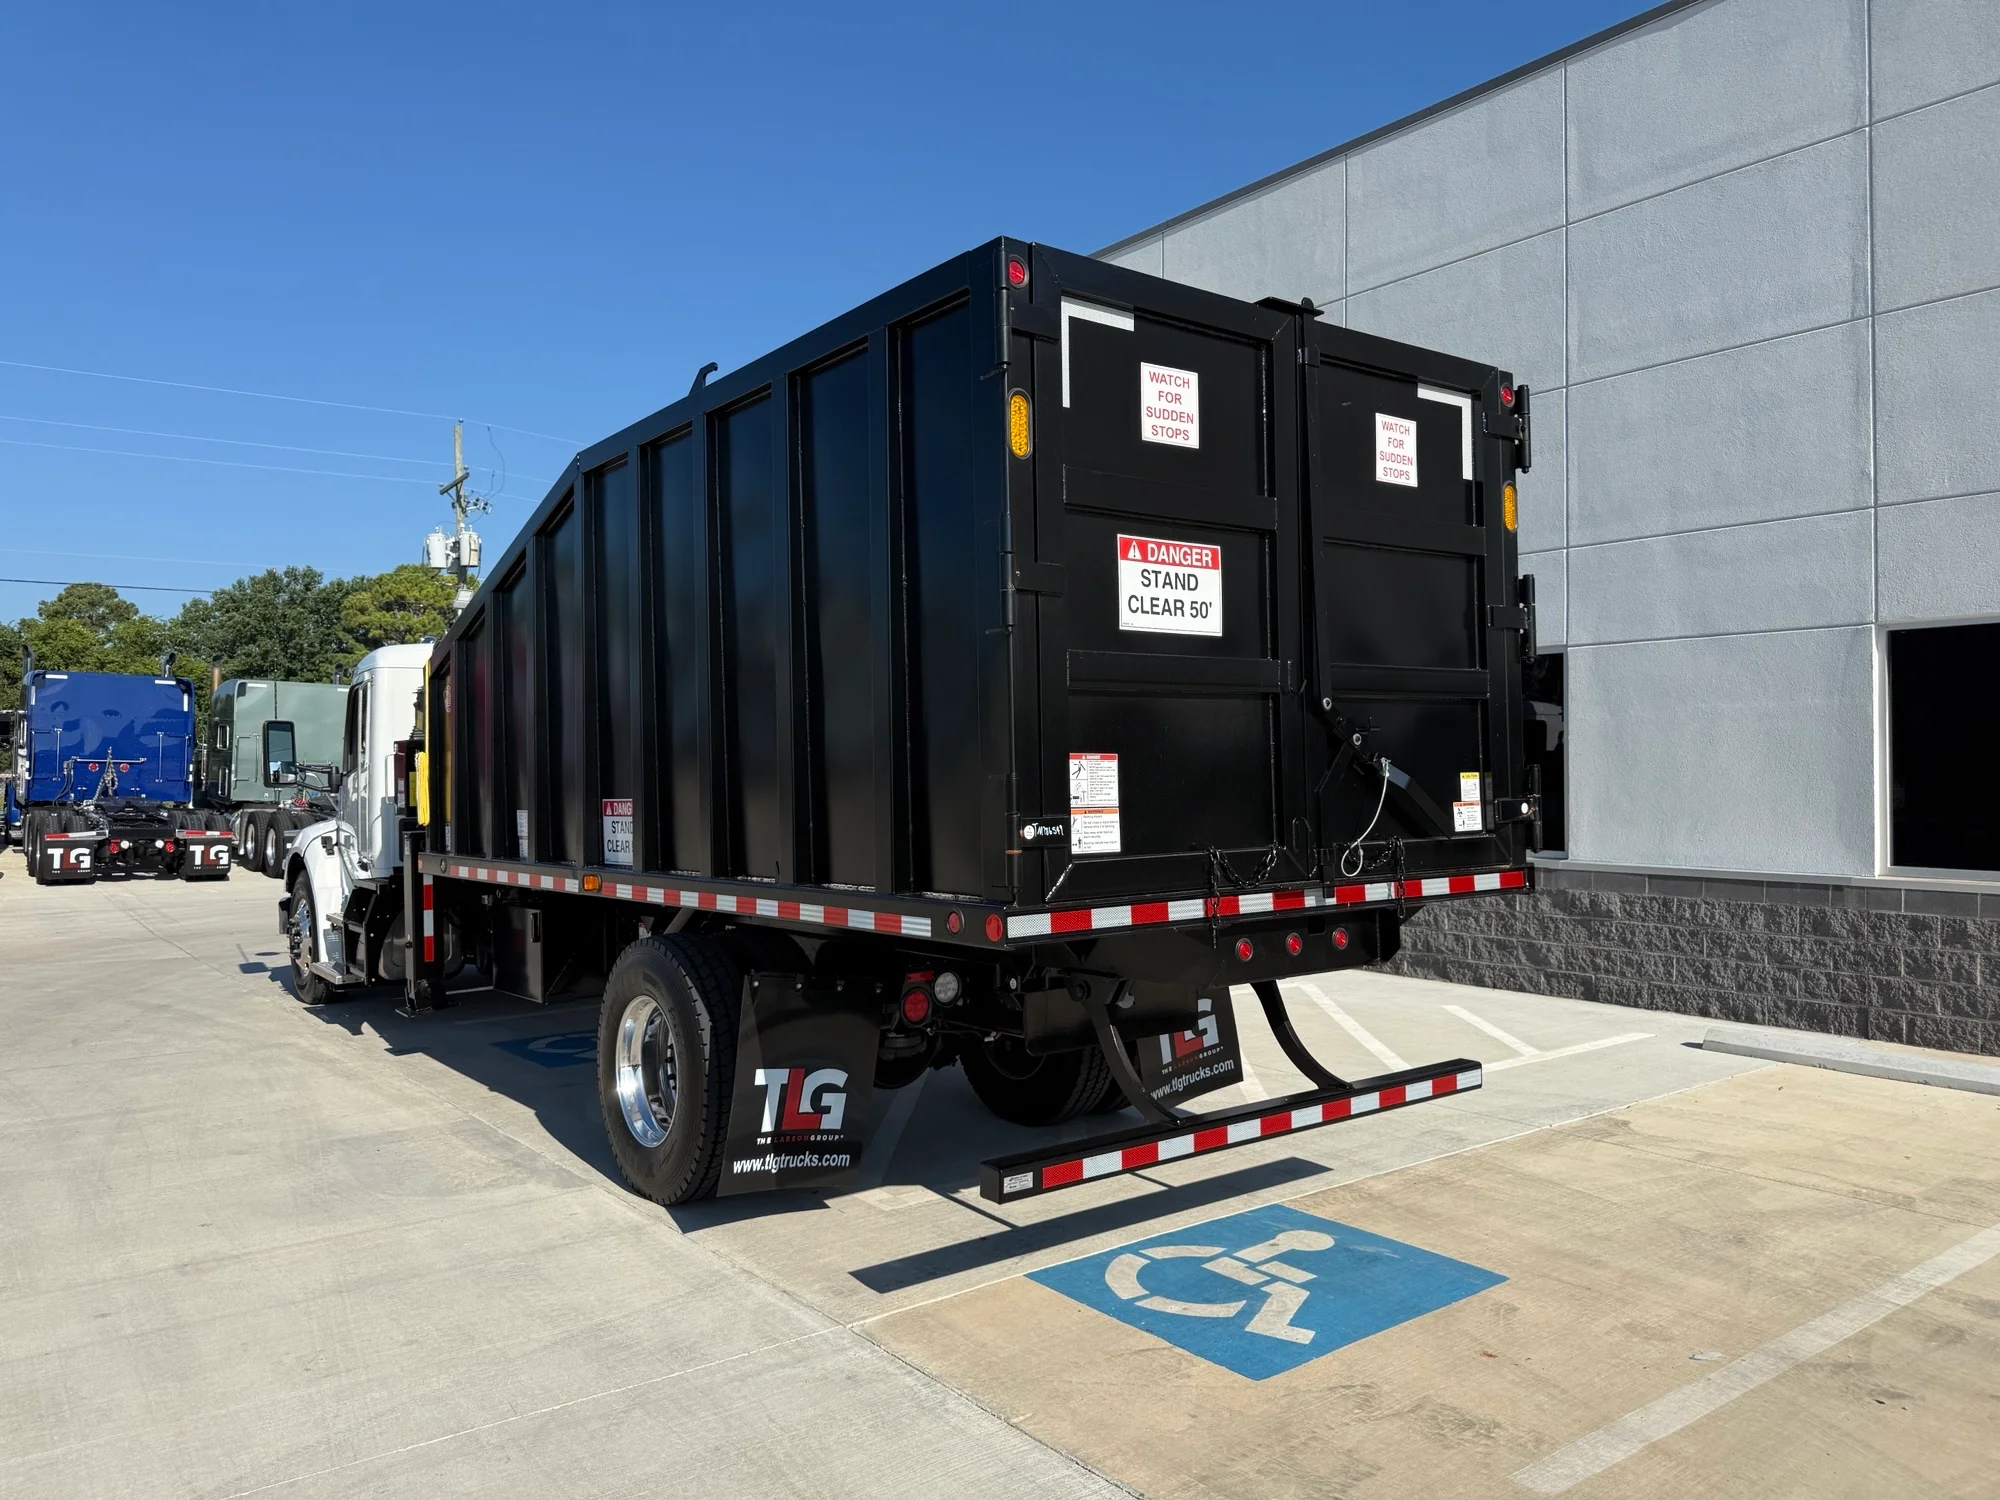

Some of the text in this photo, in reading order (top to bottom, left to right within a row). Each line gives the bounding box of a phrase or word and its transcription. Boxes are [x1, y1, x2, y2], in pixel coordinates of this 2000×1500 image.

[1149, 371, 1190, 389] WATCH
[1158, 391, 1182, 405] FOR
[1146, 406, 1194, 424] SUDDEN
[1151, 424, 1190, 441] STOPS
[1381, 420, 1410, 436] WATCH
[1388, 437, 1405, 450] FOR
[1379, 450, 1413, 466] SUDDEN
[1383, 466, 1411, 481] STOPS
[1147, 543, 1213, 567] DANGER
[1140, 568, 1199, 591] STAND
[1128, 594, 1212, 619] CLEAR 50'
[613, 802, 632, 815] DANG
[189, 844, 229, 866] TLG
[606, 839, 631, 854] CLEAR
[47, 847, 91, 869] TLG
[1150, 1059, 1235, 1100] www.tlgtrucks.com
[754, 1068, 849, 1133] TLG
[757, 1137, 772, 1145] THE
[733, 1151, 851, 1174] www.tlgtrucks.com
